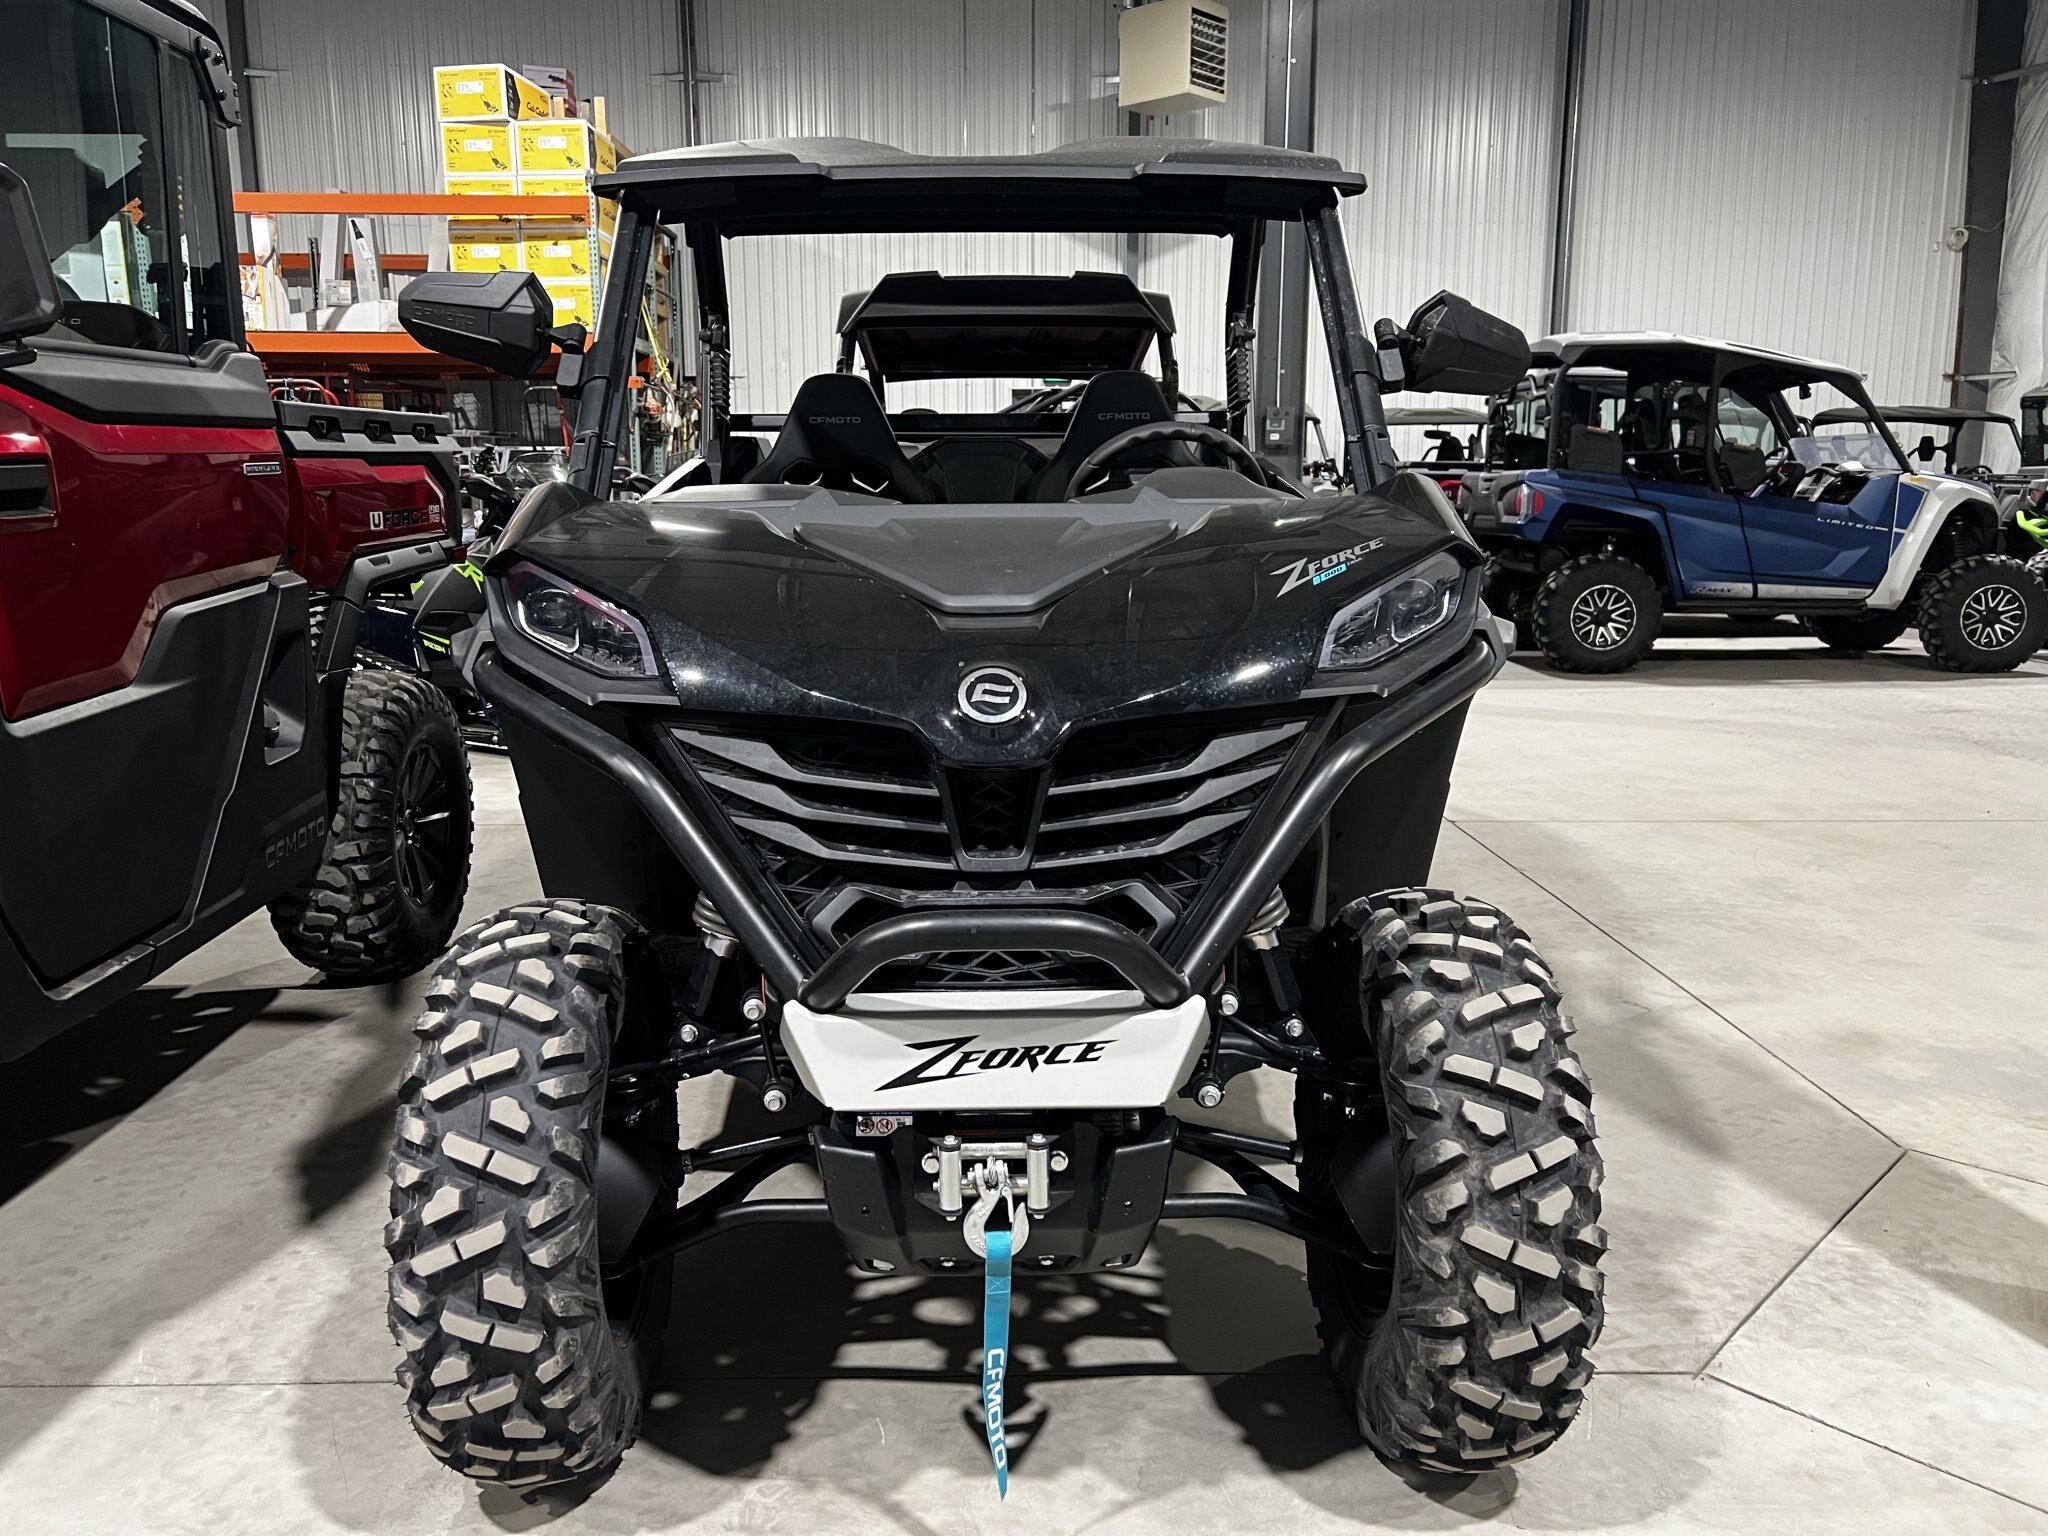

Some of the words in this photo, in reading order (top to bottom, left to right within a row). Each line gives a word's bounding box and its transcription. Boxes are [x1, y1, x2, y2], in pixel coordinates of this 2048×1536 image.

[809, 416, 861, 424] CFMOTO
[1098, 412, 1151, 420] CFMOTO
[1817, 516, 1874, 530] LIMITED
[265, 815, 325, 869] CFMOTO
[873, 1035, 1119, 1092] ZFORCE
[986, 1347, 1006, 1470] CFMOTO
